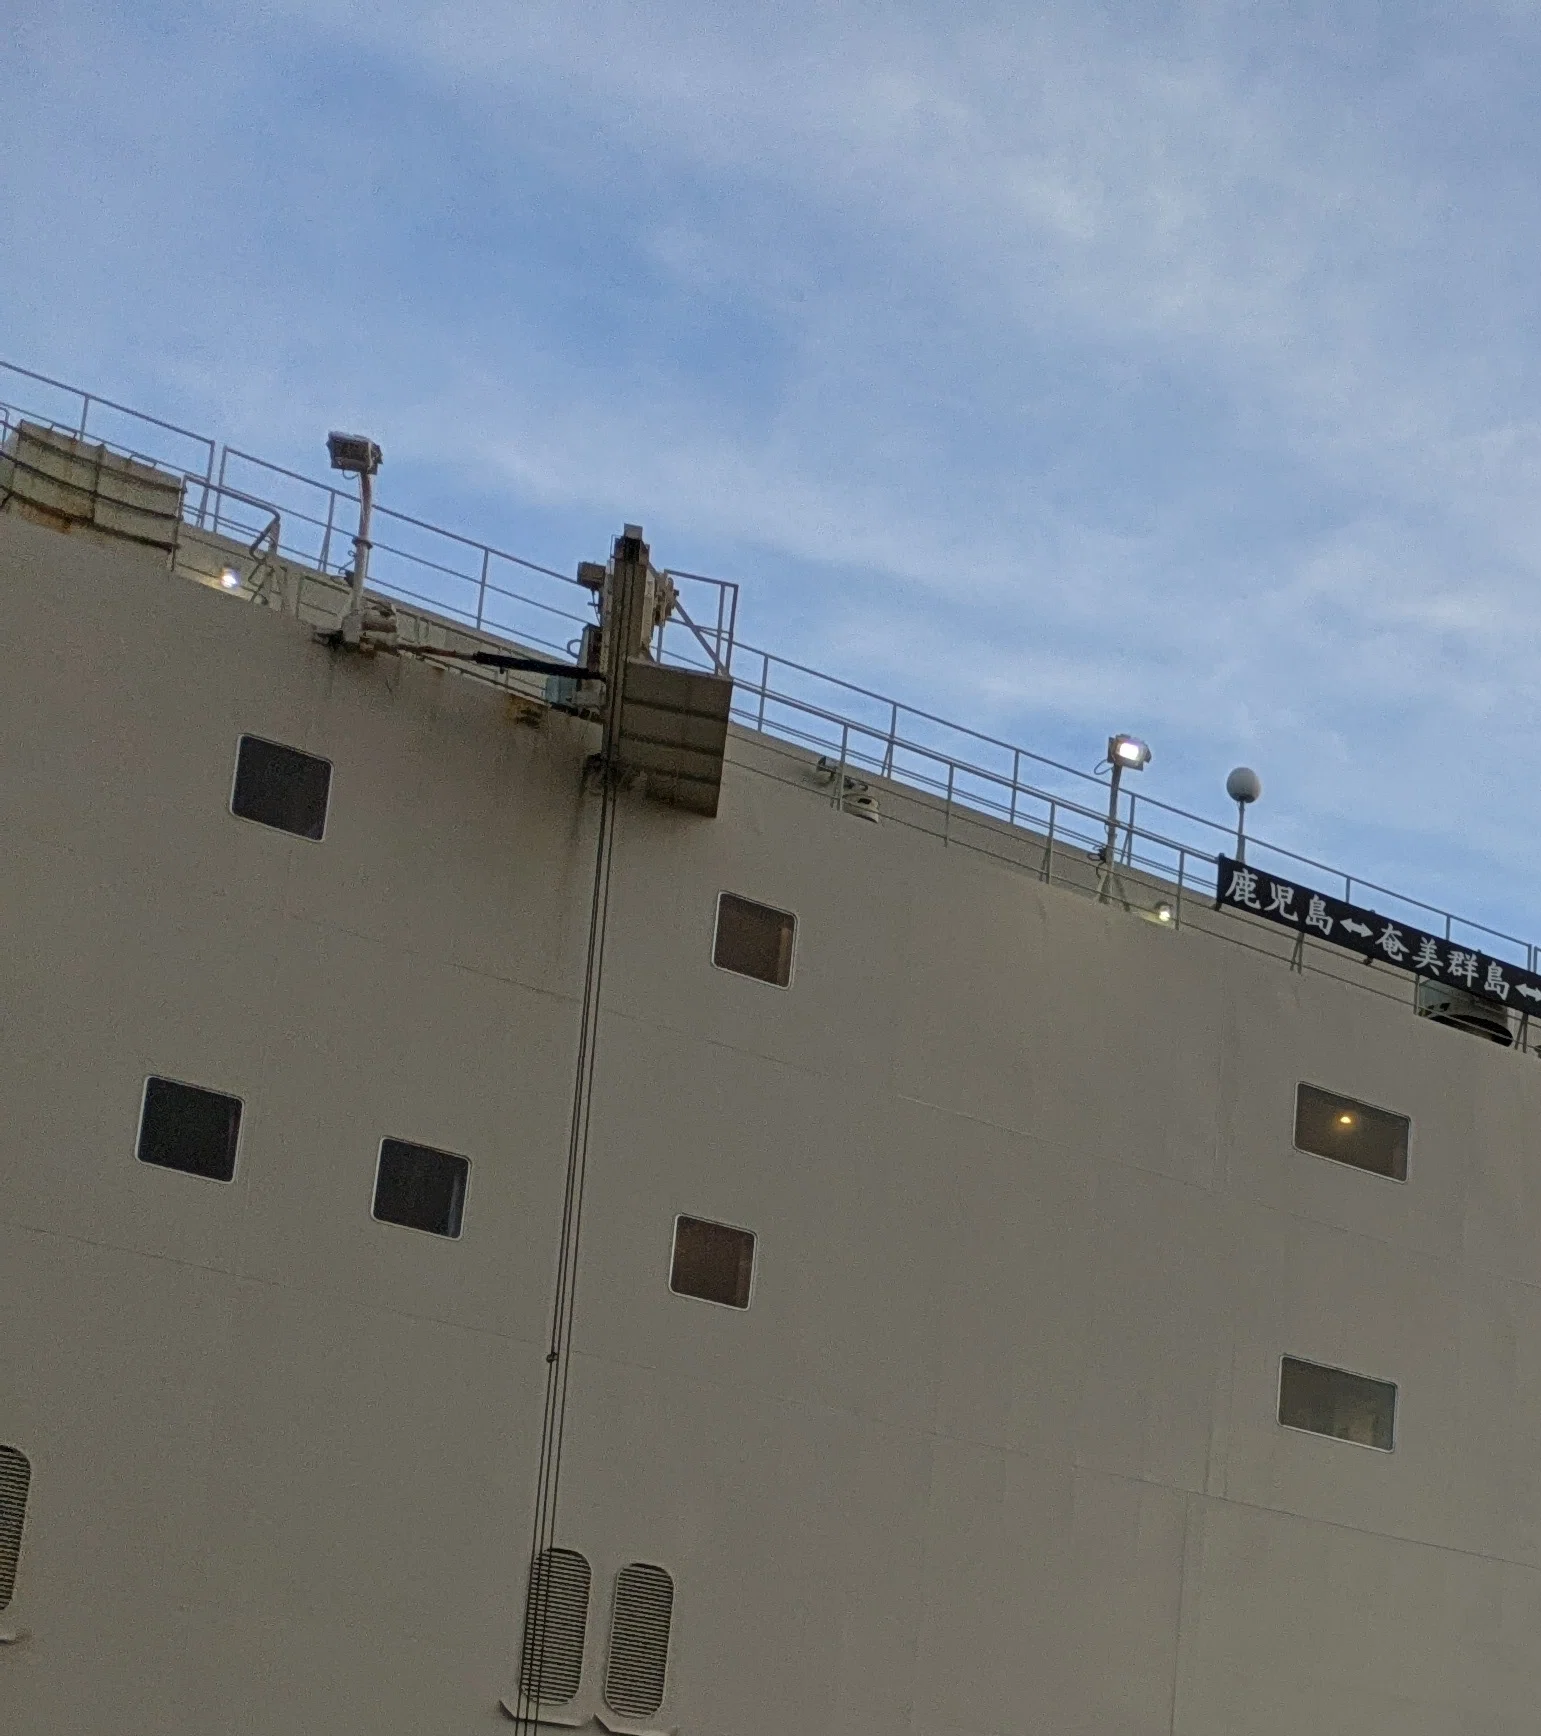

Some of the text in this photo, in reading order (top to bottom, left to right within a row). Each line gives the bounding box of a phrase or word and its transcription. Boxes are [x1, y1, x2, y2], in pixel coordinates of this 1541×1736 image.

[1225, 868, 1335, 936] 鹿児島
[1374, 922, 1509, 1002] 奄美群島
